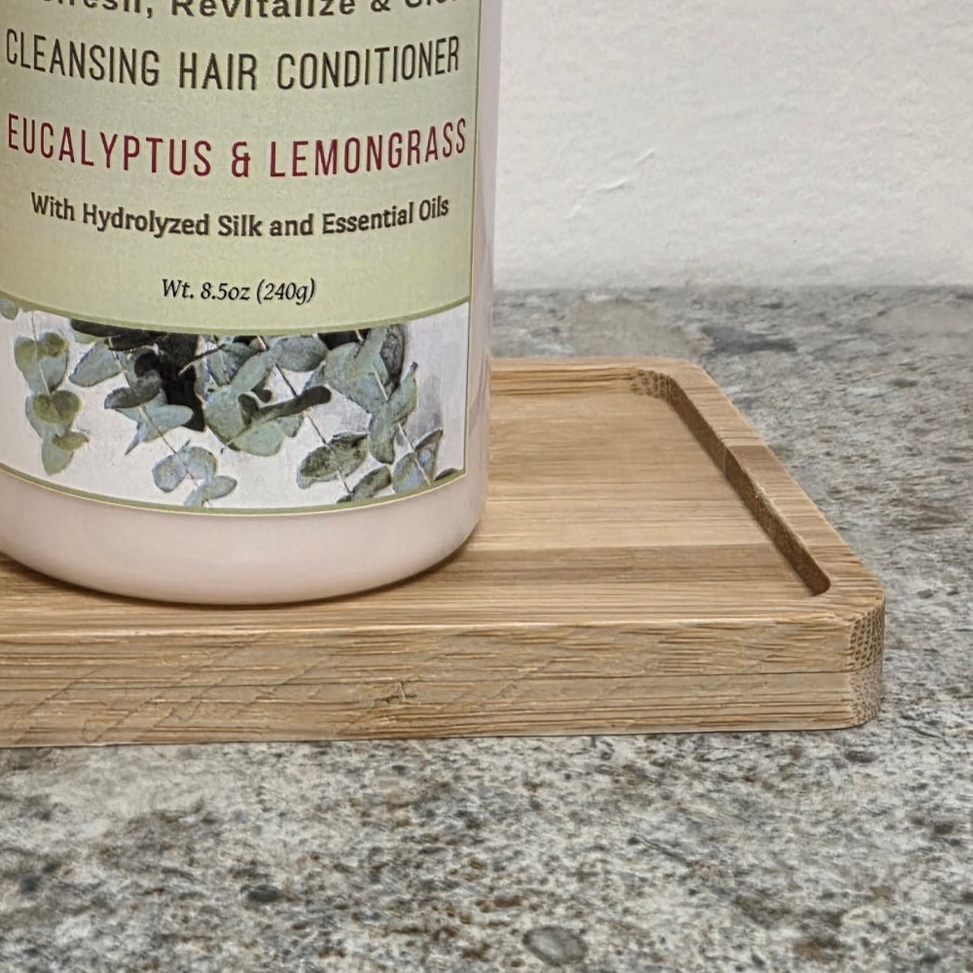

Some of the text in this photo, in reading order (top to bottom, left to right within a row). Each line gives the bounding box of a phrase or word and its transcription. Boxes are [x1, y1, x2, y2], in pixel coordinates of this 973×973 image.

[5, 28, 460, 91] CLEANSING HAIR CONDITIONER
[7, 113, 467, 178] EUCALYPTUS & LEMONGRASS
[30, 191, 450, 239] With Hydrolyzed Silk and Essential Oils
[161, 277, 316, 306] Wt. 8.5oz (240g)
